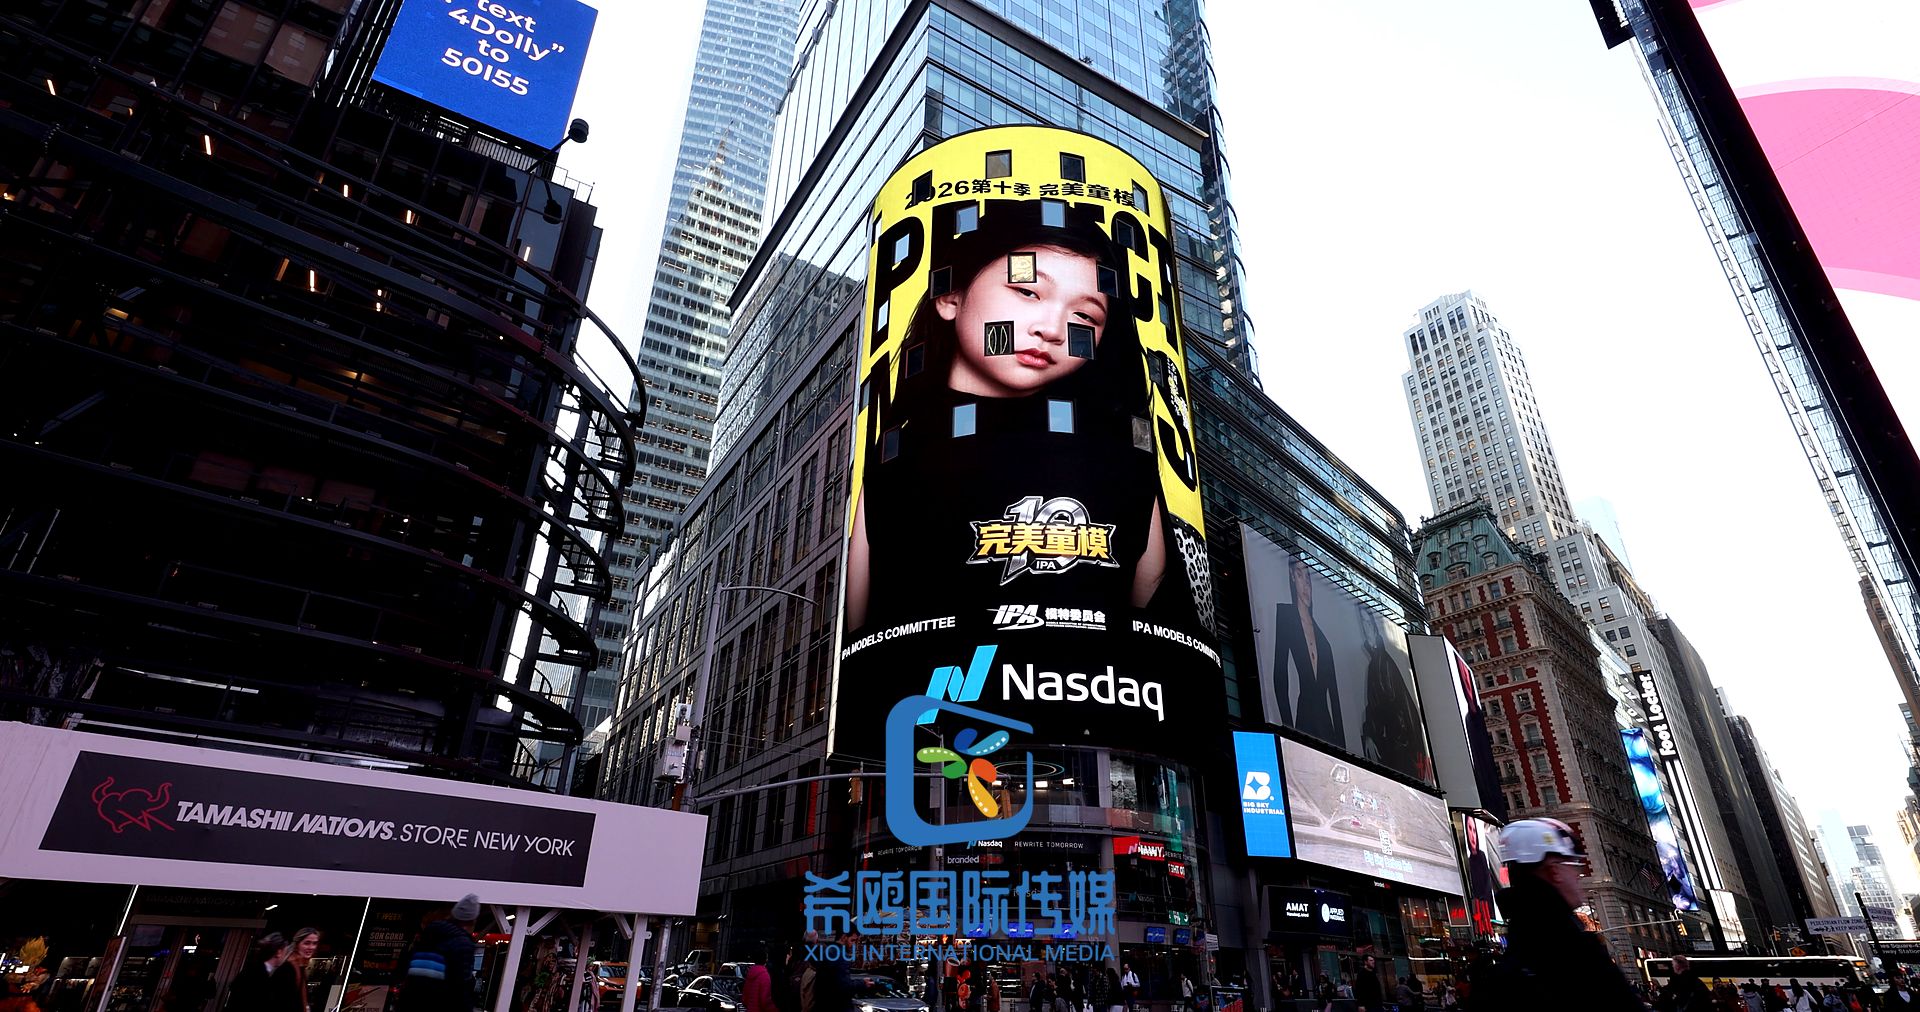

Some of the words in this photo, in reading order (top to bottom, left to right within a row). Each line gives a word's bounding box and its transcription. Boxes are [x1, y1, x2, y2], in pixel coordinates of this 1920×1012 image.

[477, 0, 537, 33] text
[478, 38, 510, 63] to
[441, 47, 530, 96] 50155
[978, 522, 1109, 559] 完美童模
[1035, 560, 1057, 571] IPA
[992, 604, 1040, 625] IPA
[851, 633, 884, 654] MODELS
[885, 616, 956, 640] COMMITTEE
[1132, 619, 1153, 635] IPA
[1153, 624, 1193, 647] MODELS
[1002, 663, 1165, 722] Nasdaq
[1652, 723, 1677, 757] Foot
[1243, 807, 1284, 816] INDUSTRIAL
[175, 800, 293, 832] TAMASHII
[292, 812, 396, 842] NATIONS
[399, 823, 467, 849] STORE
[473, 829, 520, 853] NEW
[523, 834, 575, 858] YORK
[977, 839, 1003, 850] Nasdaq
[1014, 840, 1044, 848] REWRITE
[1046, 840, 1084, 849] TOMORROW
[947, 855, 980, 864] branded
[1285, 902, 1309, 912] AMAT
